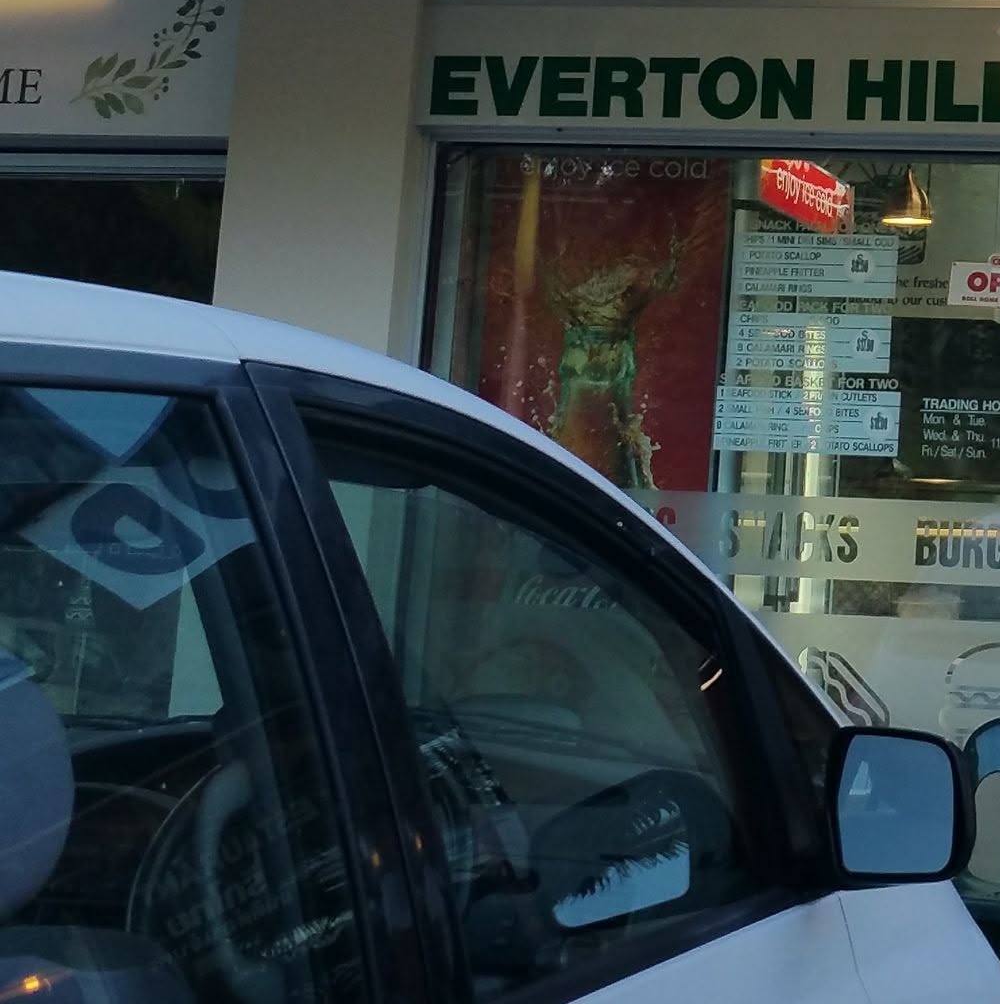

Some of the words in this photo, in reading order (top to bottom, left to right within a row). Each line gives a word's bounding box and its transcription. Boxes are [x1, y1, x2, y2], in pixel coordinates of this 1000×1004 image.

[429, 55, 815, 123] EVERTON
[648, 156, 708, 179] cold
[776, 168, 801, 205] enjoy
[815, 187, 834, 218] cold
[784, 251, 822, 261] SCALLOP
[838, 377, 868, 389] FOR
[868, 378, 899, 390] TWO
[842, 392, 878, 403] CUTLETS
[922, 398, 979, 411] TRADING
[836, 407, 860, 418] BITES
[922, 413, 945, 425] Mon
[952, 414, 961, 426] &
[951, 430, 961, 441] &
[852, 442, 895, 453] SCALLOPS
